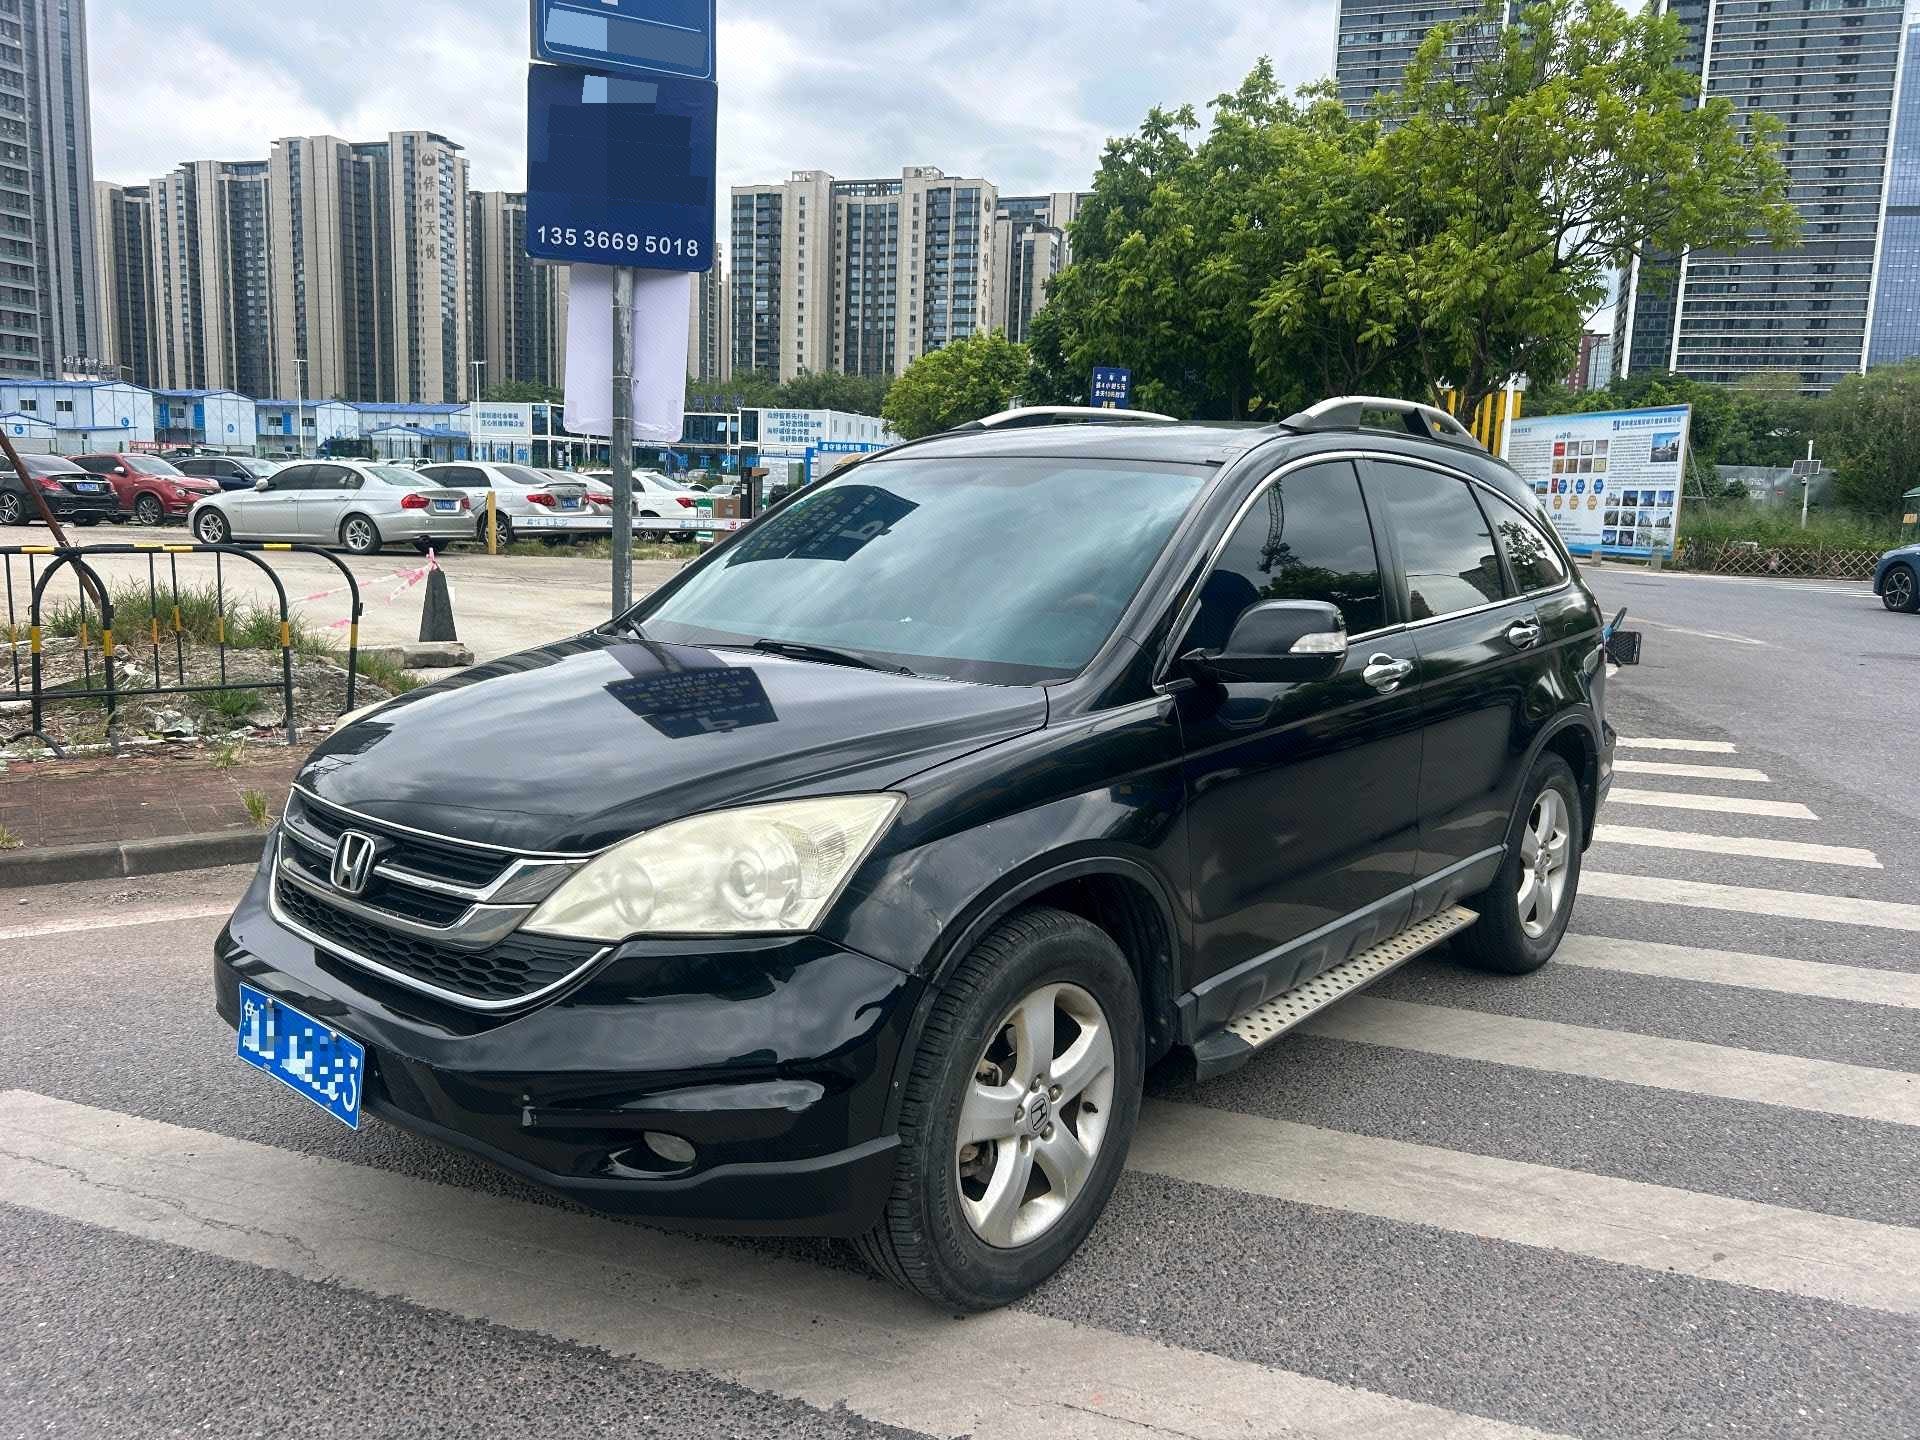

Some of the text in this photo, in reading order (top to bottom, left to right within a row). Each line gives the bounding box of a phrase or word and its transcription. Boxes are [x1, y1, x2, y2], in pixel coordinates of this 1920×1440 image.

[537, 225, 699, 257] 135 3669 5018
